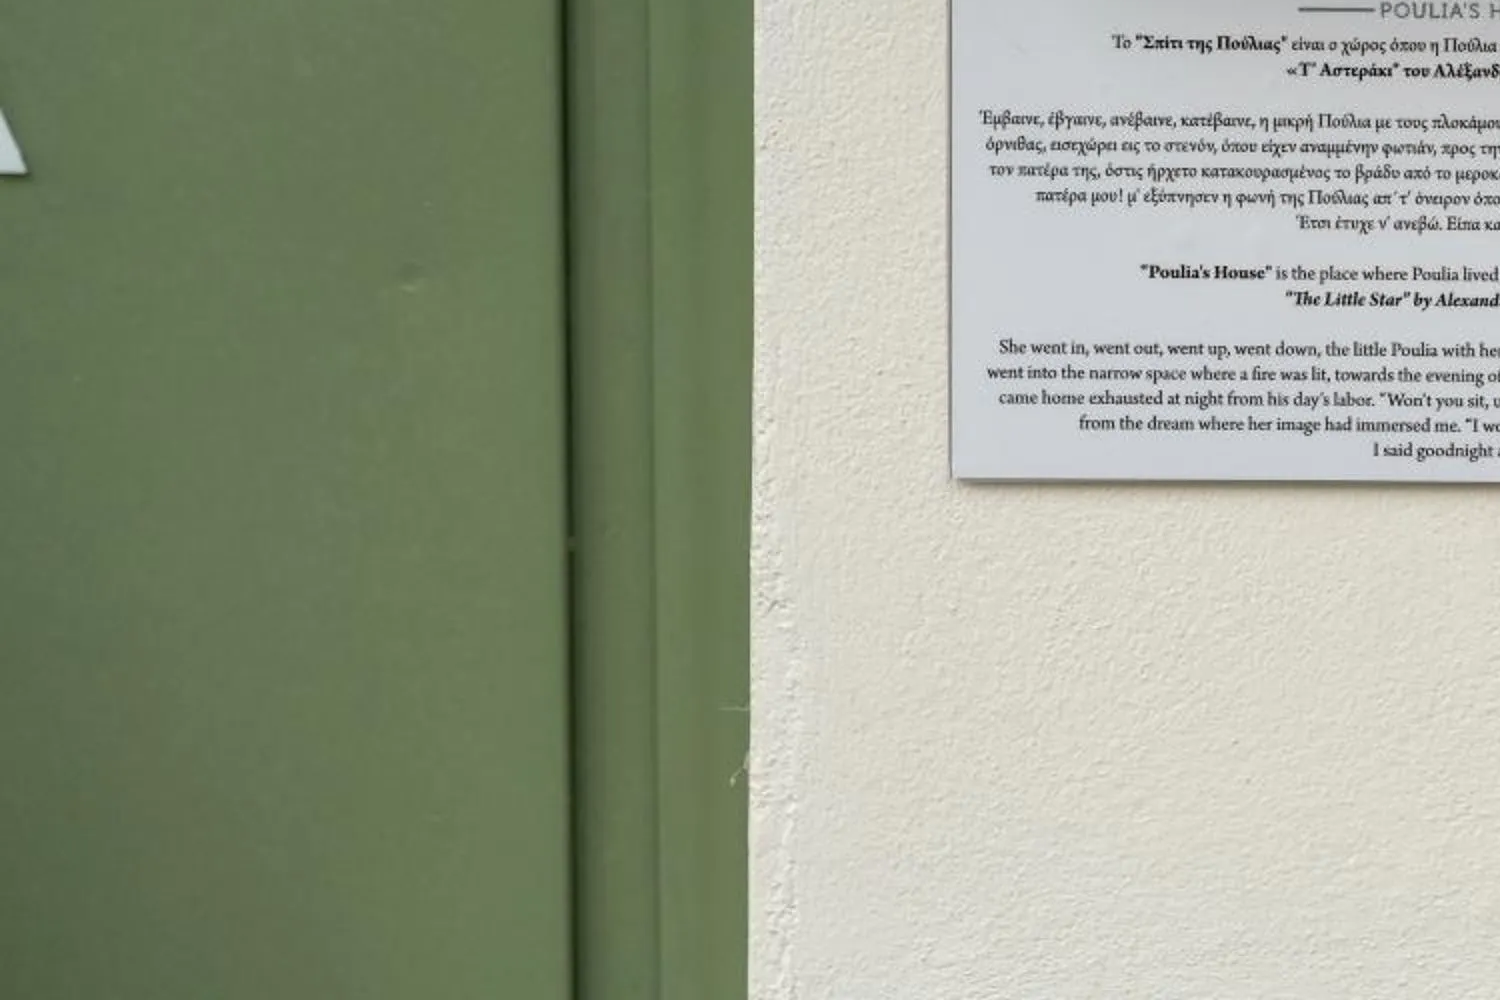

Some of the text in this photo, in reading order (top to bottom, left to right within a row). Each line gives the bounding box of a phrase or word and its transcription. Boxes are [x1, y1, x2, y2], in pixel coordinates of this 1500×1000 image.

[1380, 1, 1480, 20] POULIA'S
[1111, 33, 1133, 50] Το
[1184, 38, 1214, 56] της
[1290, 35, 1326, 52] είναι
[1327, 40, 1339, 52] ο
[1339, 36, 1388, 57] χώρος
[1388, 36, 1427, 53] όπου
[1429, 41, 1440, 57] η
[1442, 36, 1498, 54] Πούλια
[1401, 66, 1432, 79] του
[1047, 109, 1108, 132] έβγαινε,
[1109, 109, 1177, 133] ανέβαινε,
[1179, 110, 1258, 133] κατέβαινε,
[1258, 116, 1270, 133] η
[1272, 113, 1315, 134] μικρή
[1317, 112, 1373, 130] Πούλια
[1374, 117, 1393, 135] με
[1394, 117, 1430, 134] τους
[1334, 215, 1376, 236] έτυχε
[1392, 213, 1444, 236] ανεβώ.
[1445, 215, 1482, 232] Είπα
[1275, 265, 1289, 281] is
[1290, 264, 1317, 282] the
[1318, 264, 1359, 286] place
[1360, 265, 1409, 282] where
[1411, 265, 1460, 282] Poulia
[1462, 265, 1500, 283] lived
[1323, 290, 1367, 308] Little
[1412, 291, 1434, 313] by
[998, 337, 1028, 356] She
[1029, 341, 1068, 356] went
[1070, 340, 1091, 358] in,
[1092, 342, 1131, 356] went
[1132, 342, 1165, 358] out,
[1166, 343, 1206, 356] went
[1207, 344, 1232, 361] up,
[1233, 343, 1272, 358] went
[1274, 339, 1323, 359] down,
[1324, 339, 1351, 358] the
[1352, 340, 1388, 358] little
[1390, 341, 1439, 358] Poulia
[1440, 341, 1477, 359] with
[997, 393, 1039, 406] came
[1040, 388, 1086, 406] home
[1087, 388, 1164, 409] exhausted
[1166, 392, 1182, 407] at
[1183, 389, 1225, 412] night
[1226, 389, 1265, 407] from
[1266, 389, 1291, 407] his
[1332, 390, 1376, 408] labor.
[1434, 396, 1465, 413] you
[1466, 393, 1490, 411] sit,
[1078, 413, 1116, 431] from
[1118, 414, 1145, 432] the
[1146, 414, 1196, 432] dream
[1197, 415, 1246, 432] where
[1247, 415, 1274, 432] her
[1275, 416, 1322, 437] image
[1324, 415, 1354, 433] had
[1355, 416, 1432, 434] immersed
[1432, 421, 1463, 434] me.
[1372, 441, 1380, 457] I
[1382, 440, 1414, 458] said
[1414, 441, 1495, 464] goodnight
